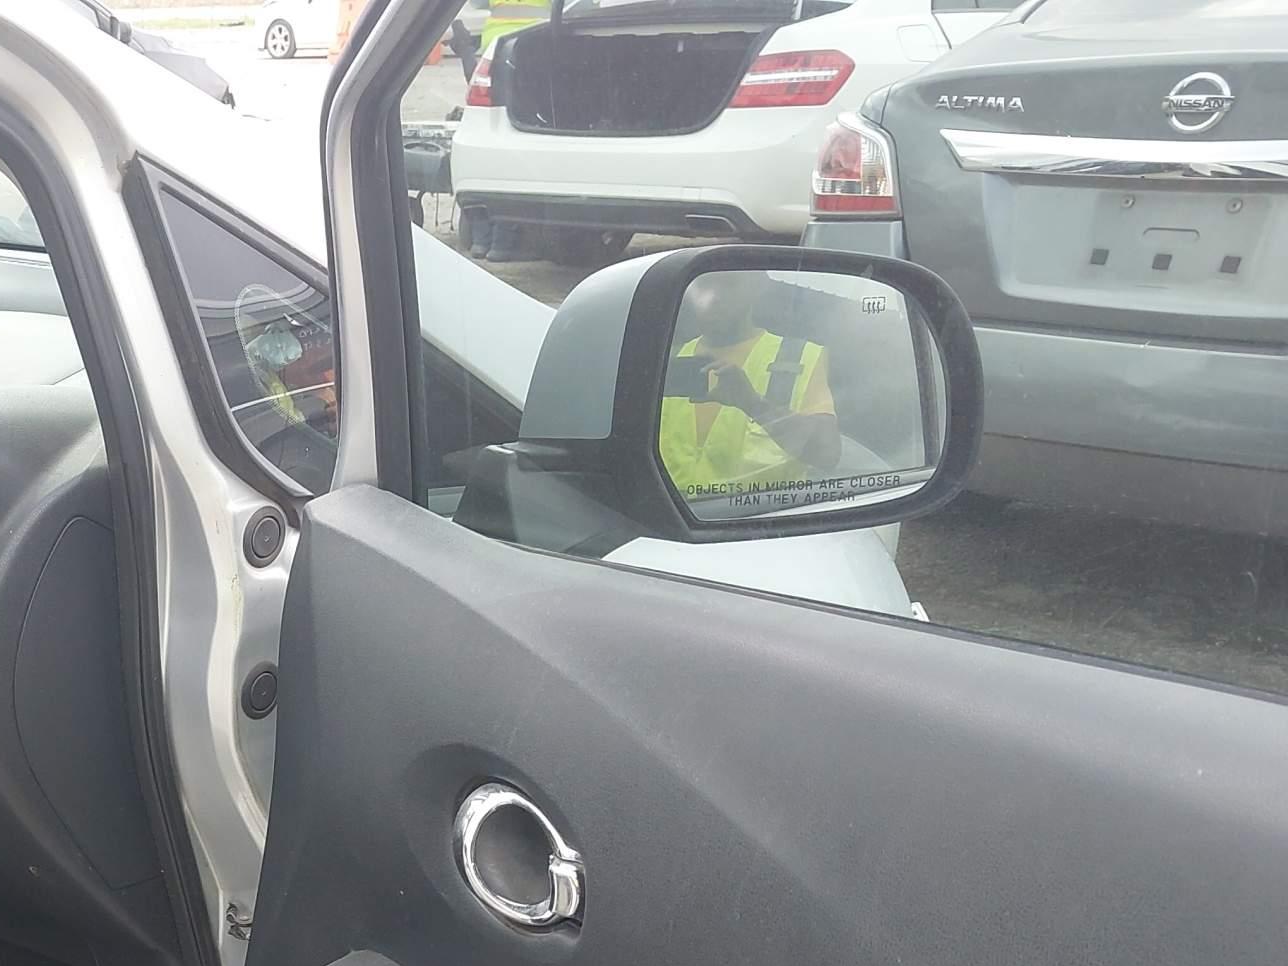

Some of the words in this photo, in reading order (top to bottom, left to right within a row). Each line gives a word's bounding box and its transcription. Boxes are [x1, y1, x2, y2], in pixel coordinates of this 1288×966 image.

[935, 94, 1025, 113] ALTIMA
[1168, 98, 1225, 110] NISSAN
[687, 483, 744, 495] OBJECTS
[748, 483, 760, 493] IN
[765, 479, 813, 492] MIRROR
[818, 478, 844, 490] ARE
[849, 474, 901, 488] CLOSER
[728, 494, 761, 507] THAN
[767, 492, 797, 504] THEY
[805, 490, 856, 502] APPEAR
